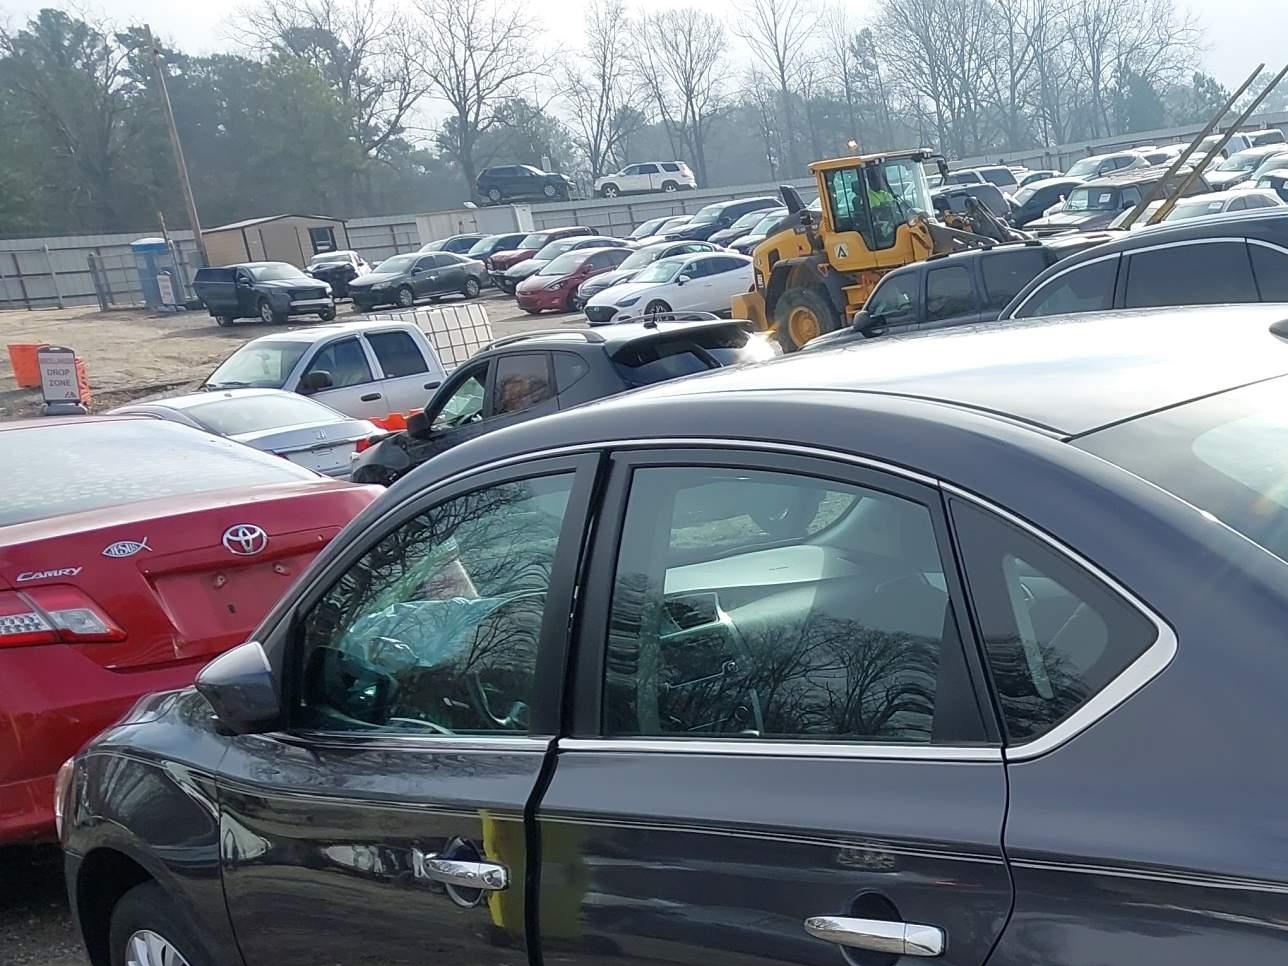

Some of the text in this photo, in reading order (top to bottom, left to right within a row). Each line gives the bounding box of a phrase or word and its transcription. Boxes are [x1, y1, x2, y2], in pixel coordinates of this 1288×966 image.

[46, 368, 70, 376] DROP
[48, 379, 71, 387] ZONE
[16, 566, 82, 582] CAMRY
